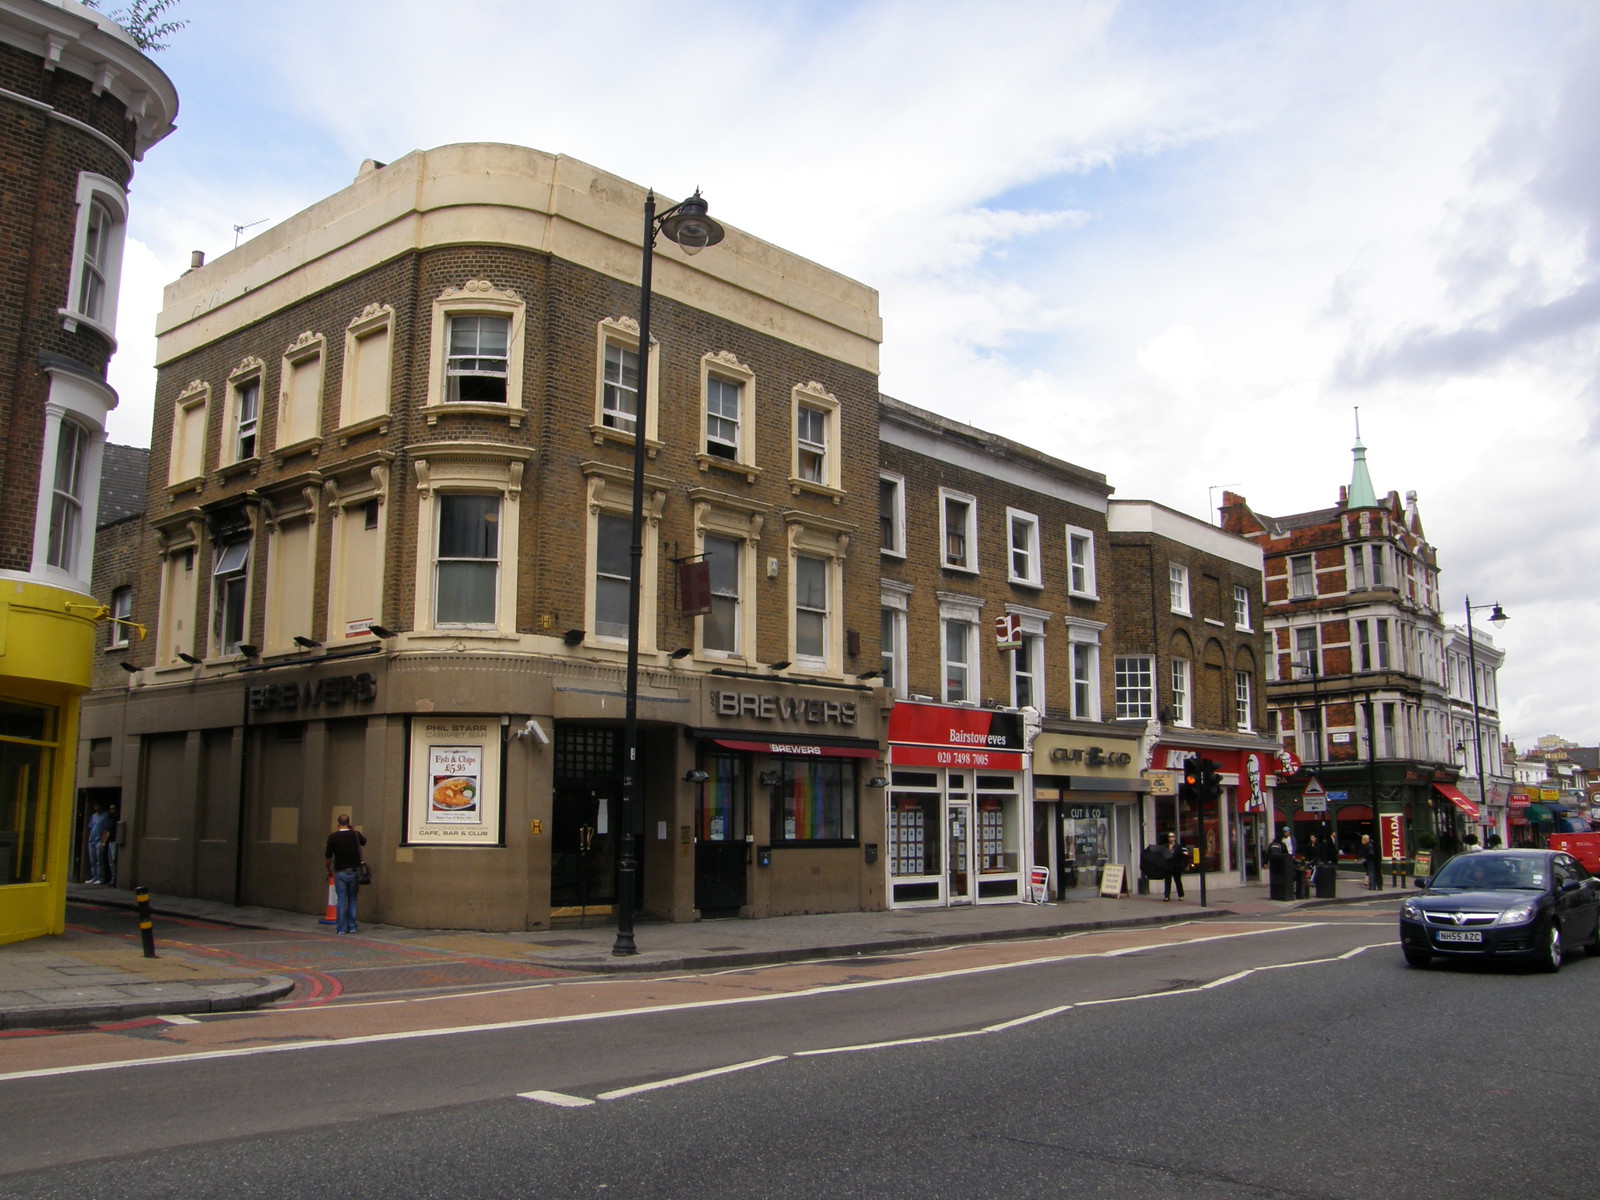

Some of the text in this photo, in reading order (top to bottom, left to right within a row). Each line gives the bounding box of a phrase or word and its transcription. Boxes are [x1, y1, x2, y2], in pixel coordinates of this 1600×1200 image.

[249, 672, 377, 711] BREWERS
[717, 690, 858, 724] BREWERS
[426, 724, 487, 732] PHIL STARR
[949, 728, 1006, 745] Bairstow eves
[771, 744, 822, 755] BREWERS
[435, 755, 475, 765] Fish & Chips
[937, 751, 989, 765] 020 7498 7005
[1050, 747, 1085, 763] CUT
[1085, 746, 1106, 768] &
[1071, 808, 1101, 818] CUT & CO
[1390, 815, 1401, 860] STRADA
[1440, 932, 1480, 941] NH55 AZC
